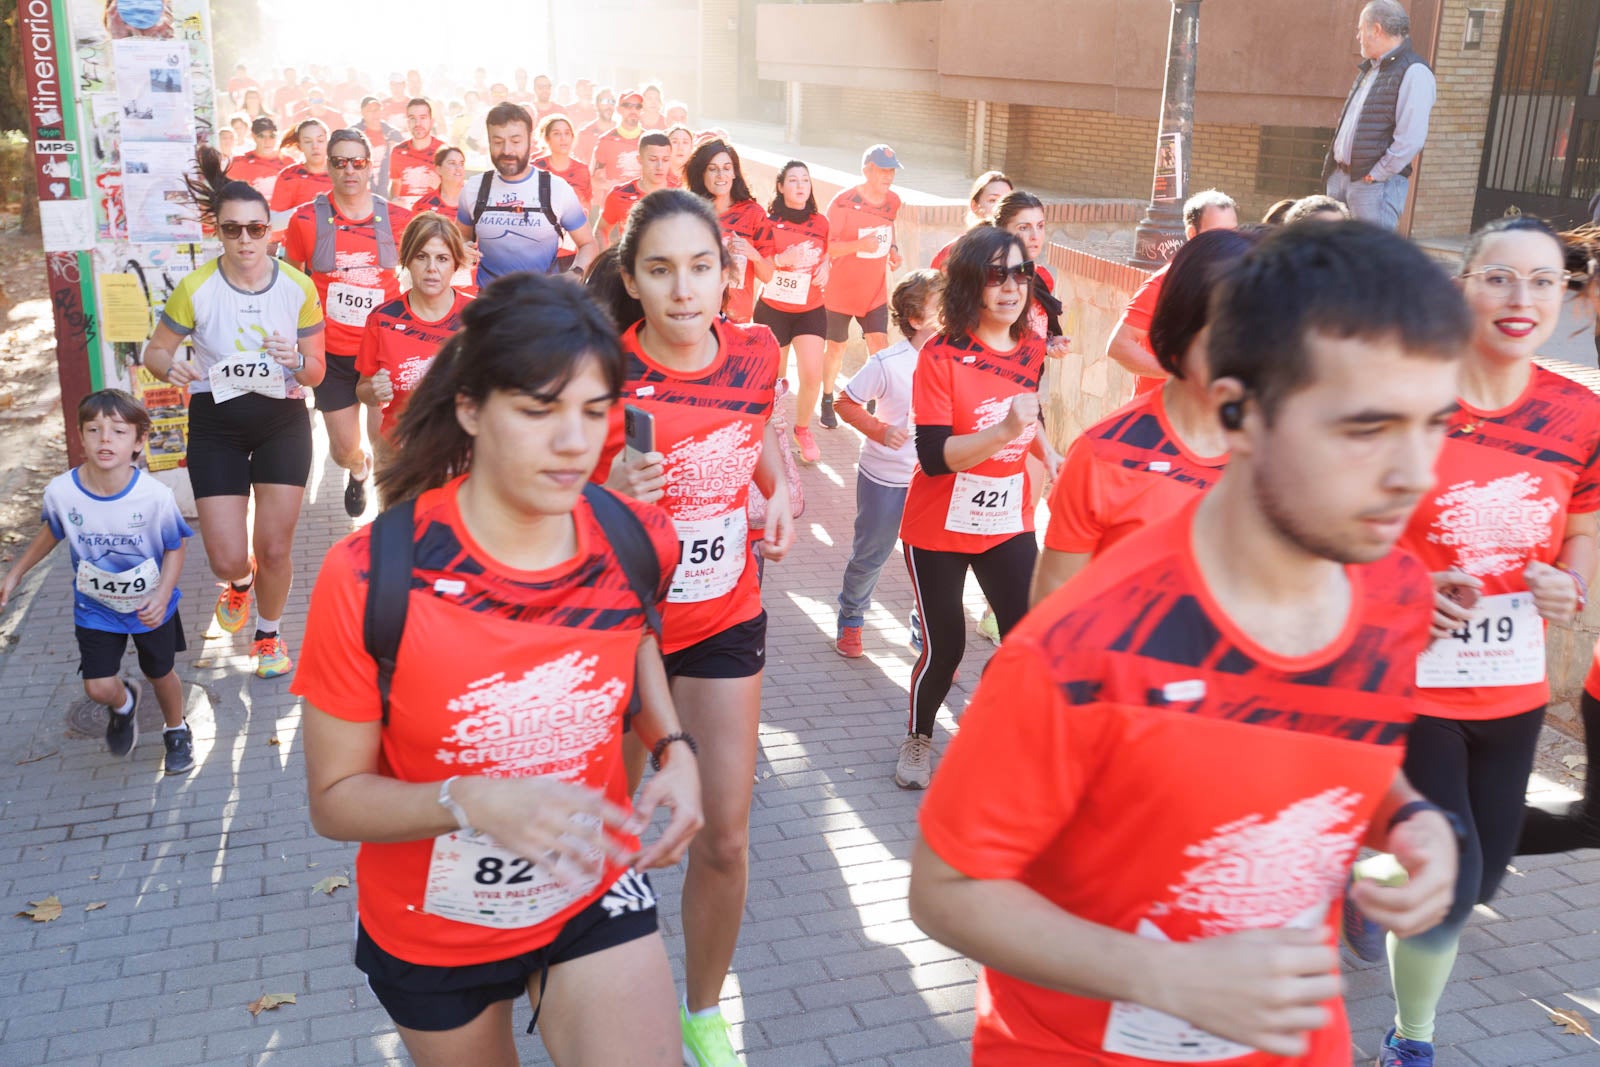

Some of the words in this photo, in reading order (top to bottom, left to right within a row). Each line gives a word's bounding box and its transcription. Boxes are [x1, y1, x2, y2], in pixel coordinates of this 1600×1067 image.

[38, 143, 75, 152] MPS
[479, 216, 541, 227] MARACENA
[776, 276, 797, 289] 358
[336, 291, 373, 309] 1503
[221, 362, 270, 378] 1673
[971, 490, 1008, 508] 421
[684, 568, 715, 578] BLANCA
[89, 577, 146, 594] 1479
[1452, 616, 1514, 644] 419
[456, 693, 615, 744] carrera
[458, 726, 609, 765] cruzroja.es
